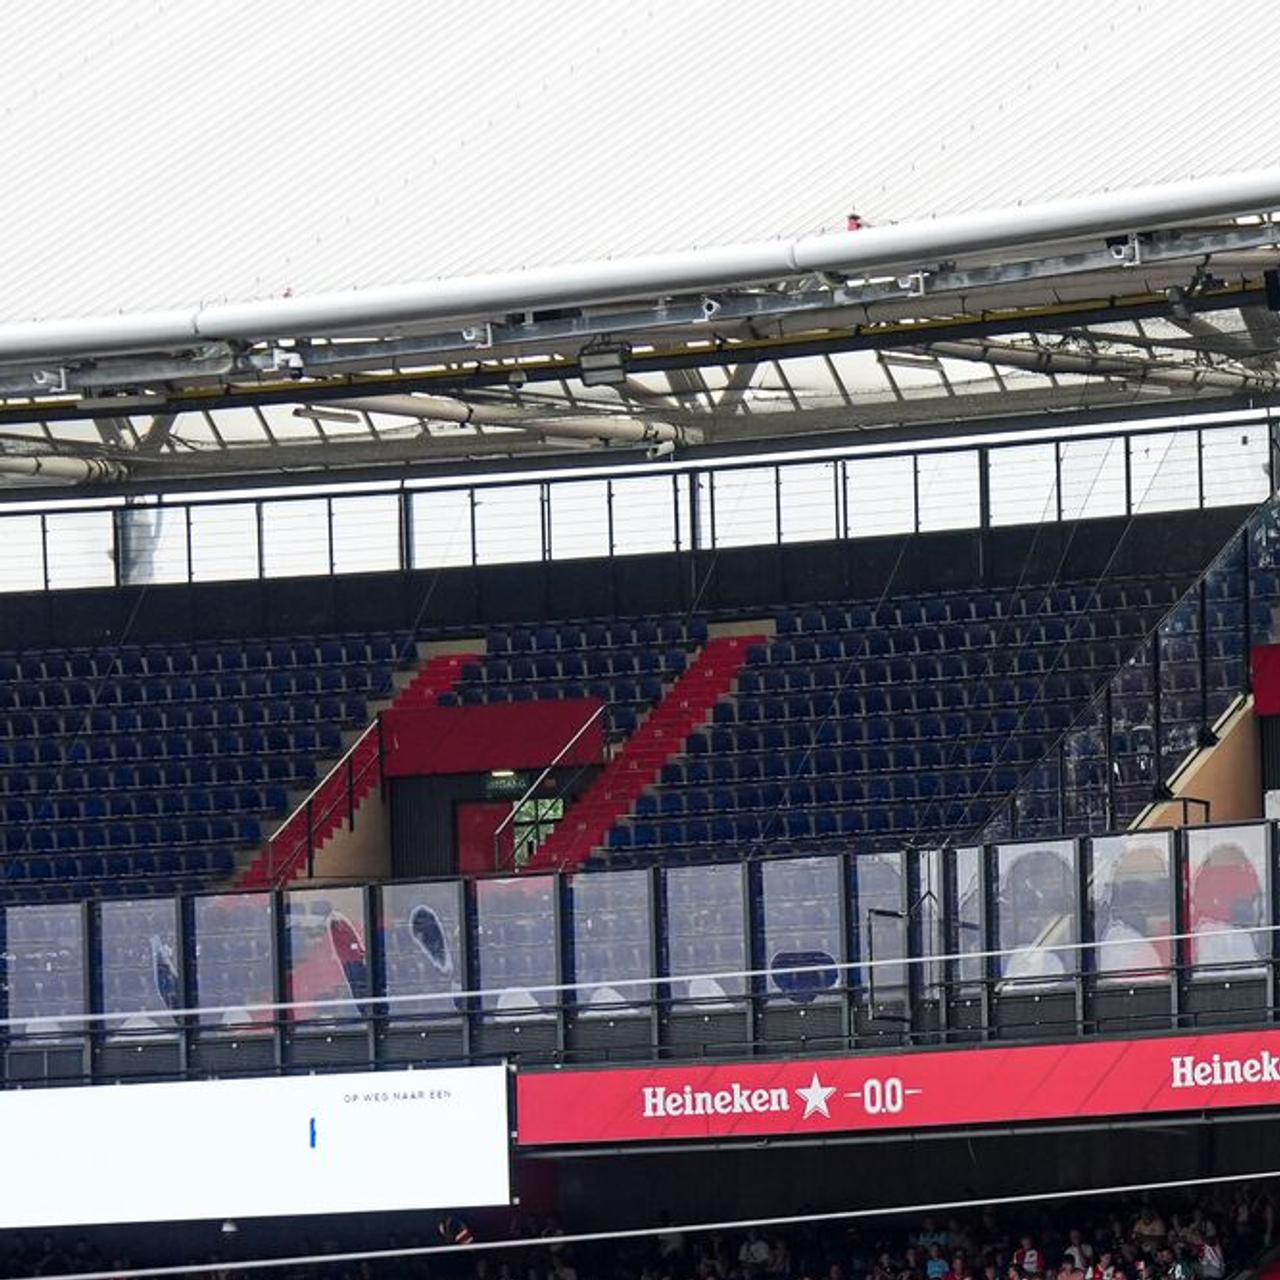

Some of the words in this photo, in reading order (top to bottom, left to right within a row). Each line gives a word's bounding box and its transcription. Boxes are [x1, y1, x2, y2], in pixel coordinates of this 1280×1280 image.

[393, 1090, 425, 1101] NAAR
[430, 1089, 452, 1100] EEN
[642, 1083, 790, 1118] Heineken
[863, 1077, 904, 1114] 0.0
